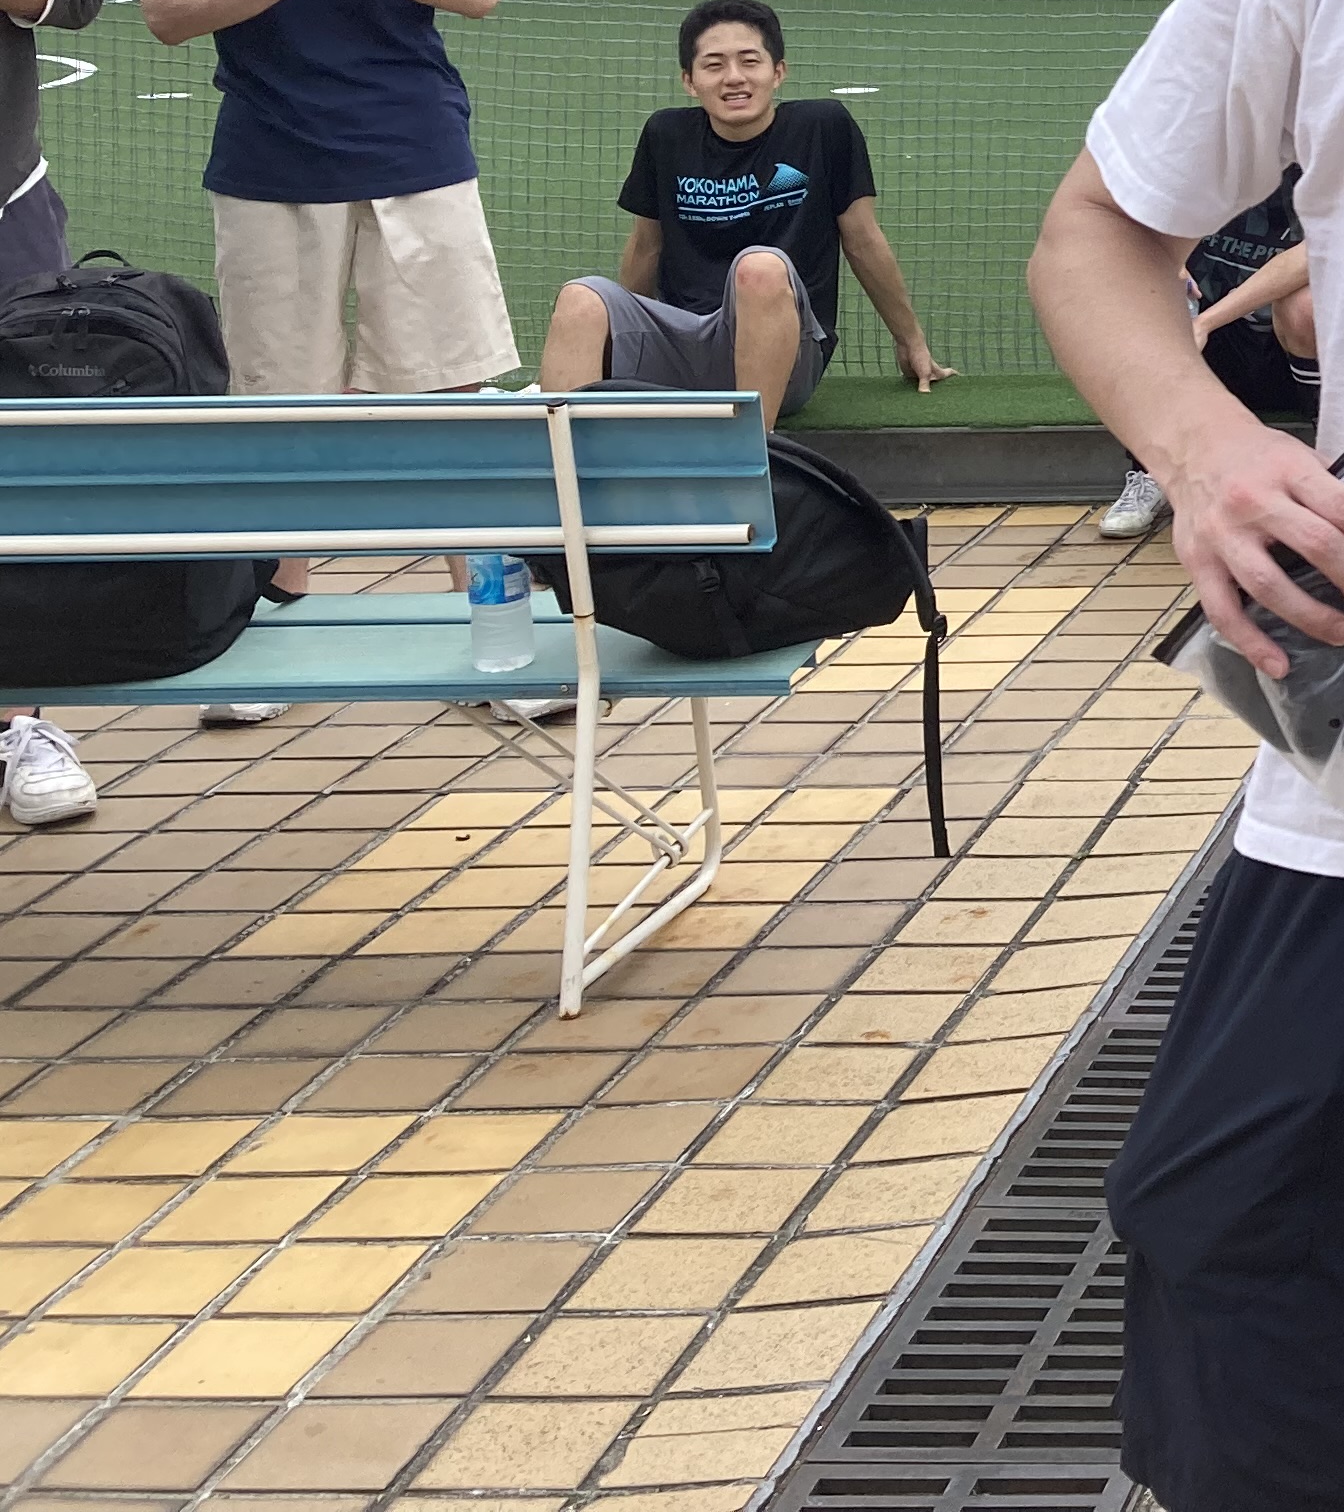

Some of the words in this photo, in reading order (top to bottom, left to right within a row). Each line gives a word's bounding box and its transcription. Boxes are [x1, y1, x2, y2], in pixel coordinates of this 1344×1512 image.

[676, 174, 760, 194] YOKOHAMA
[676, 190, 760, 206] MARATHON
[1221, 235, 1254, 259] THE
[39, 363, 106, 377] Columbia
